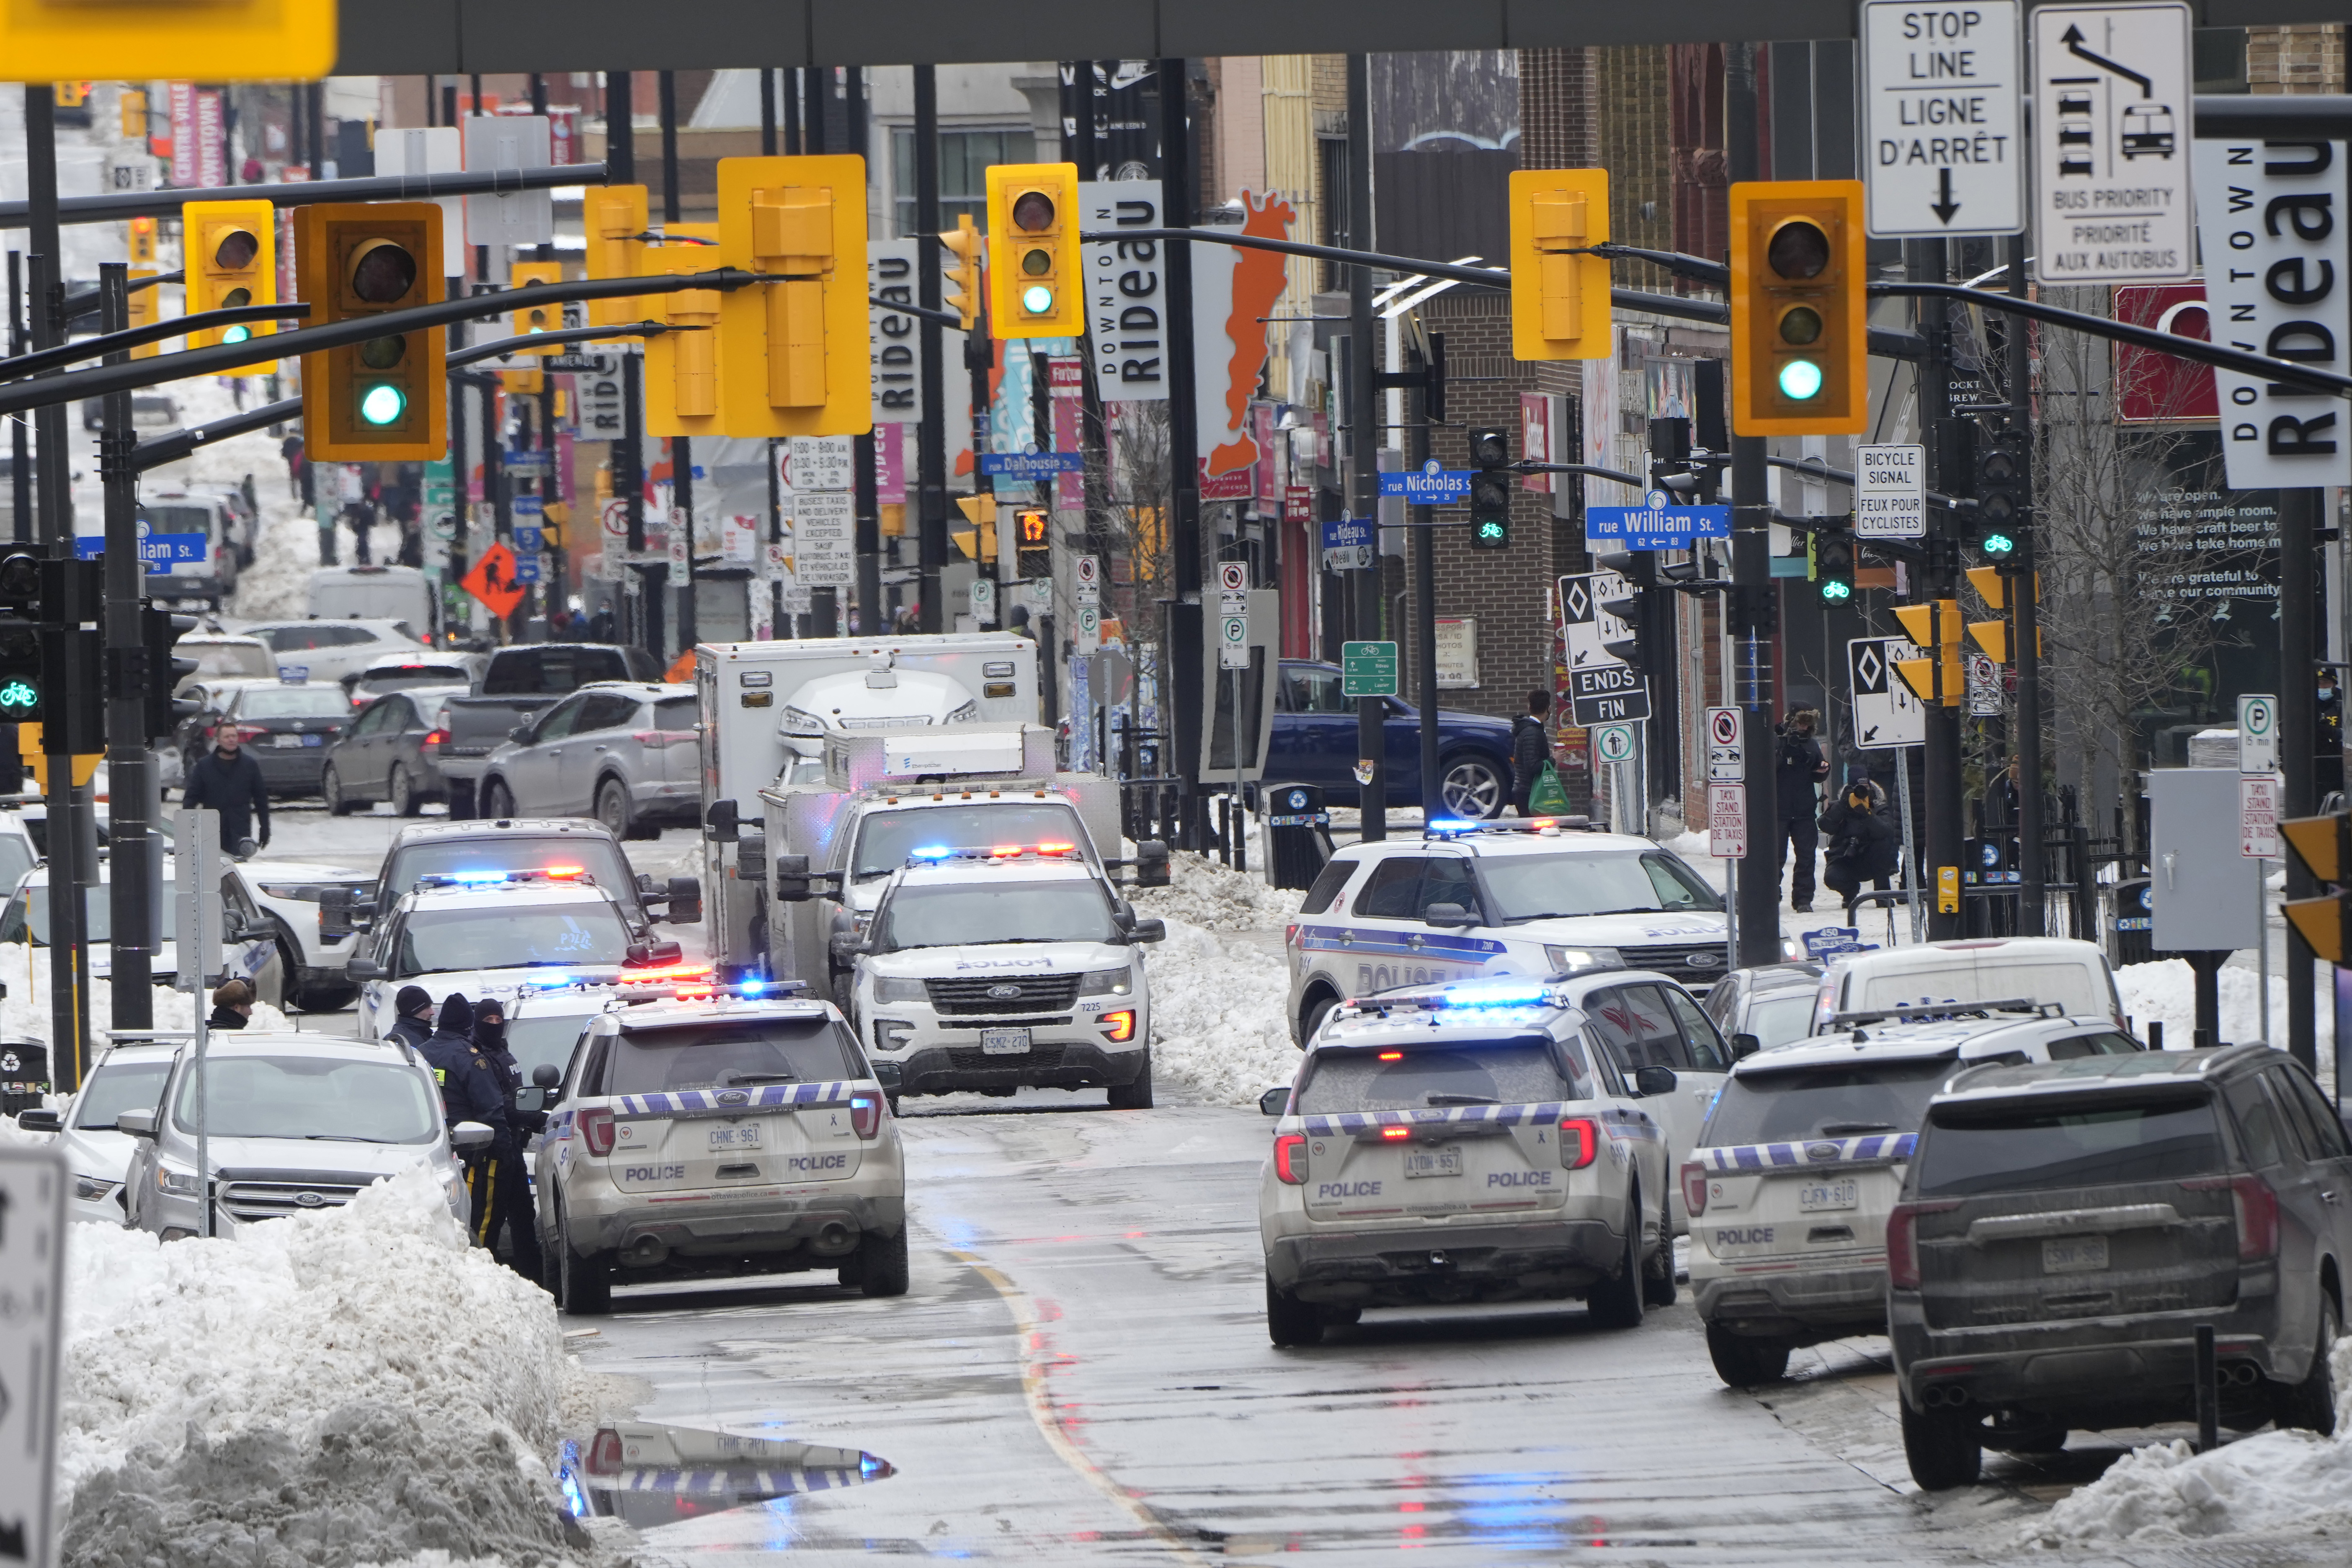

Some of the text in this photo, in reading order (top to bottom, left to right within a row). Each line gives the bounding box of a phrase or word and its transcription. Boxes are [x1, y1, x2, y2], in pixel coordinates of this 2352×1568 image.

[1903, 11, 1981, 39] STOP
[1910, 51, 1977, 80] LINE
[1900, 98, 1987, 126] LIGNE
[198, 95, 220, 187] OWNTOWN
[1880, 133, 2008, 166] D'ARRÊT
[2054, 187, 2173, 210] BUS PRIORITY
[2073, 220, 2152, 245] PRIORITÉ
[2055, 249, 2178, 271] AUX AUTOBUS
[1950, 381, 1981, 389] OCKT
[1004, 455, 1060, 471] Dalhousie
[1865, 453, 1915, 466] BICYCLE
[1388, 474, 1471, 492] rue Nicholas S
[1869, 471, 1912, 484] SIGNAL
[2184, 491, 2221, 503] open.
[1861, 498, 1919, 512] FEUX POUR
[2161, 509, 2192, 519] have
[2239, 506, 2277, 516] room.
[1599, 511, 1715, 533] rue William St.
[1862, 517, 1919, 530] CYCLISTES
[2137, 524, 2157, 536] We
[2196, 522, 2227, 534] craft
[2231, 521, 2261, 533] beer
[2263, 521, 2277, 531] to
[1337, 523, 1359, 540] Rideau
[1638, 537, 1679, 547] 62 83
[2196, 538, 2225, 549] take
[2229, 537, 2266, 548] home
[137, 539, 193, 560] liam St.
[2188, 570, 2259, 585] grateful to
[2179, 587, 2202, 598] our
[1086, 614, 1093, 625] P
[1231, 624, 1240, 637] P
[1581, 670, 1635, 693] ENDS
[1598, 699, 1625, 719] FIN
[2253, 708, 2264, 727] P
[2246, 735, 2253, 746] 15
[1720, 789, 1735, 800] TAXI
[2250, 784, 2268, 796] TAXI
[1716, 802, 1739, 813] STAND
[2247, 797, 2272, 809] STAND
[1714, 816, 1742, 828] STATION
[2245, 813, 2275, 825] STATION
[1713, 829, 1743, 840] DE TAXIS
[2243, 827, 2277, 838] DE TAXIS
[1819, 928, 1839, 937] 450
[994, 985, 1014, 997] Ford
[1081, 1003, 1101, 1012] 7225
[1011, 1034, 1027, 1047] 270
[710, 1129, 759, 1144] CHNE 961
[788, 1154, 846, 1171] POLICE
[1439, 1153, 1459, 1168] 557
[626, 1165, 685, 1182] POLICE
[1488, 1171, 1552, 1188] POLICE
[711, 1191, 768, 1201] ottawapolice.ca
[1318, 1181, 1382, 1199] POLICE
[301, 1194, 319, 1204] Ford
[1716, 1228, 1774, 1246] POLICE
